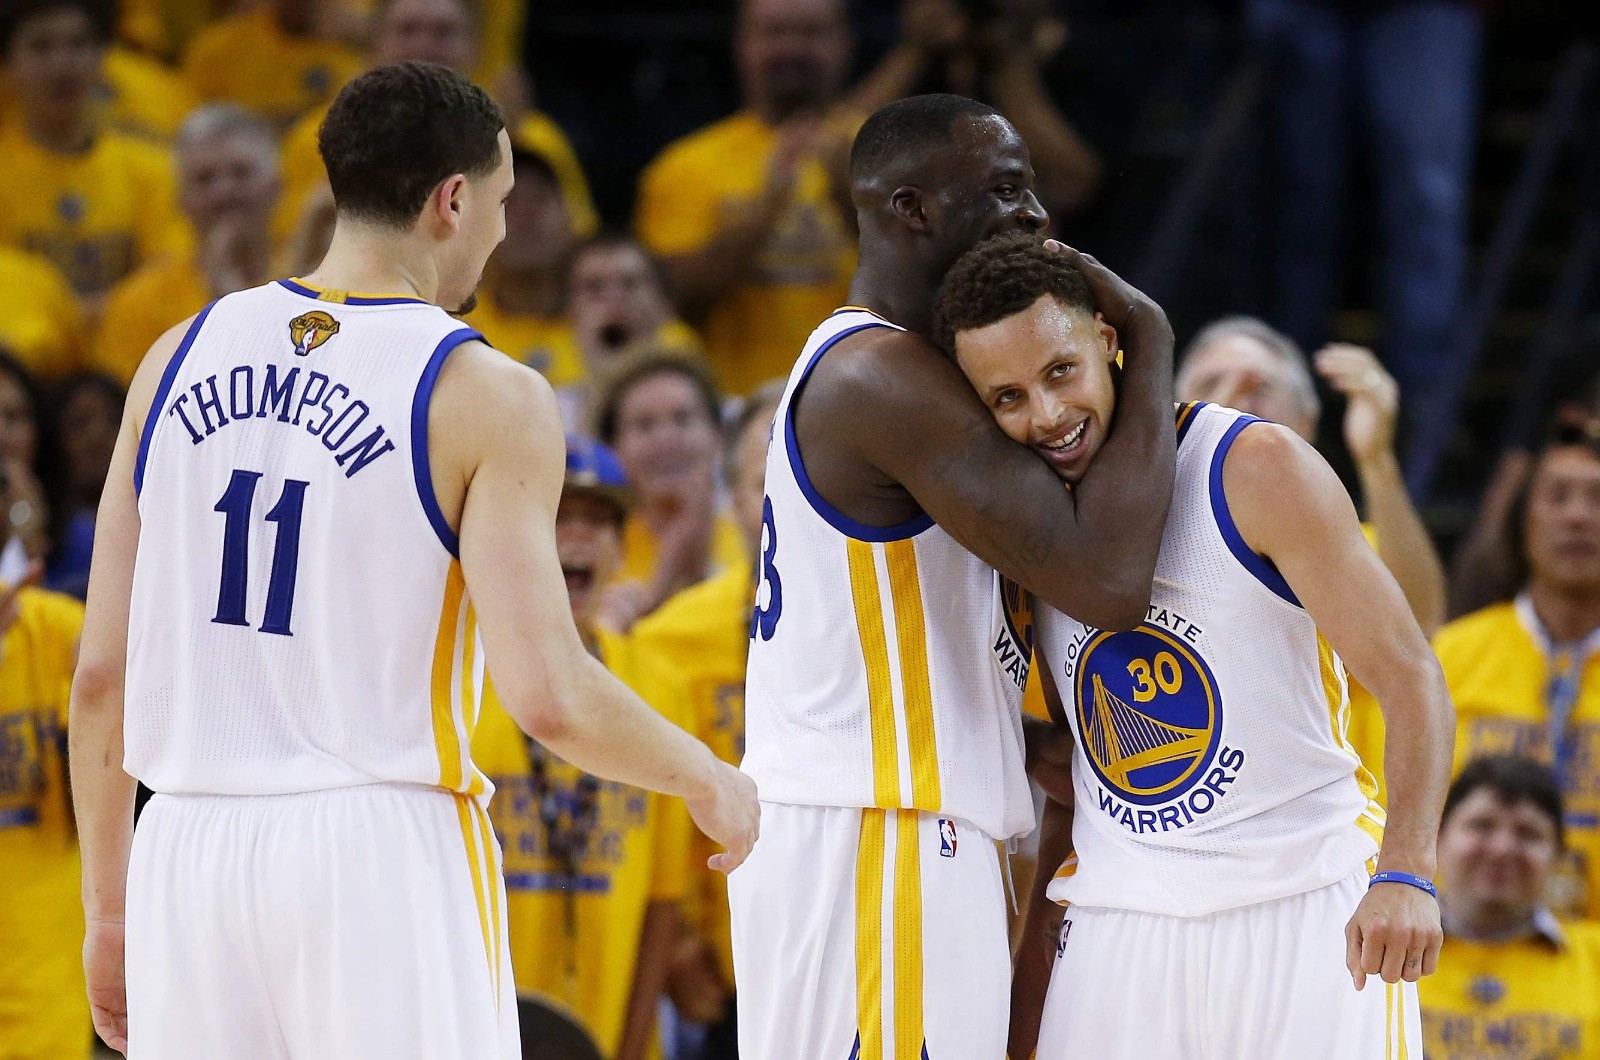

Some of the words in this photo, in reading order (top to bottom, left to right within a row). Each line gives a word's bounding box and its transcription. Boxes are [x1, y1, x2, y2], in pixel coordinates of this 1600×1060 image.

[170, 364, 395, 479] THOMPSON
[211, 469, 310, 636] 11
[750, 494, 782, 641] 3
[994, 626, 1029, 692] WAR
[1148, 605, 1202, 644] TATE
[1127, 651, 1183, 702] 30
[1098, 746, 1245, 834] WARRIORS
